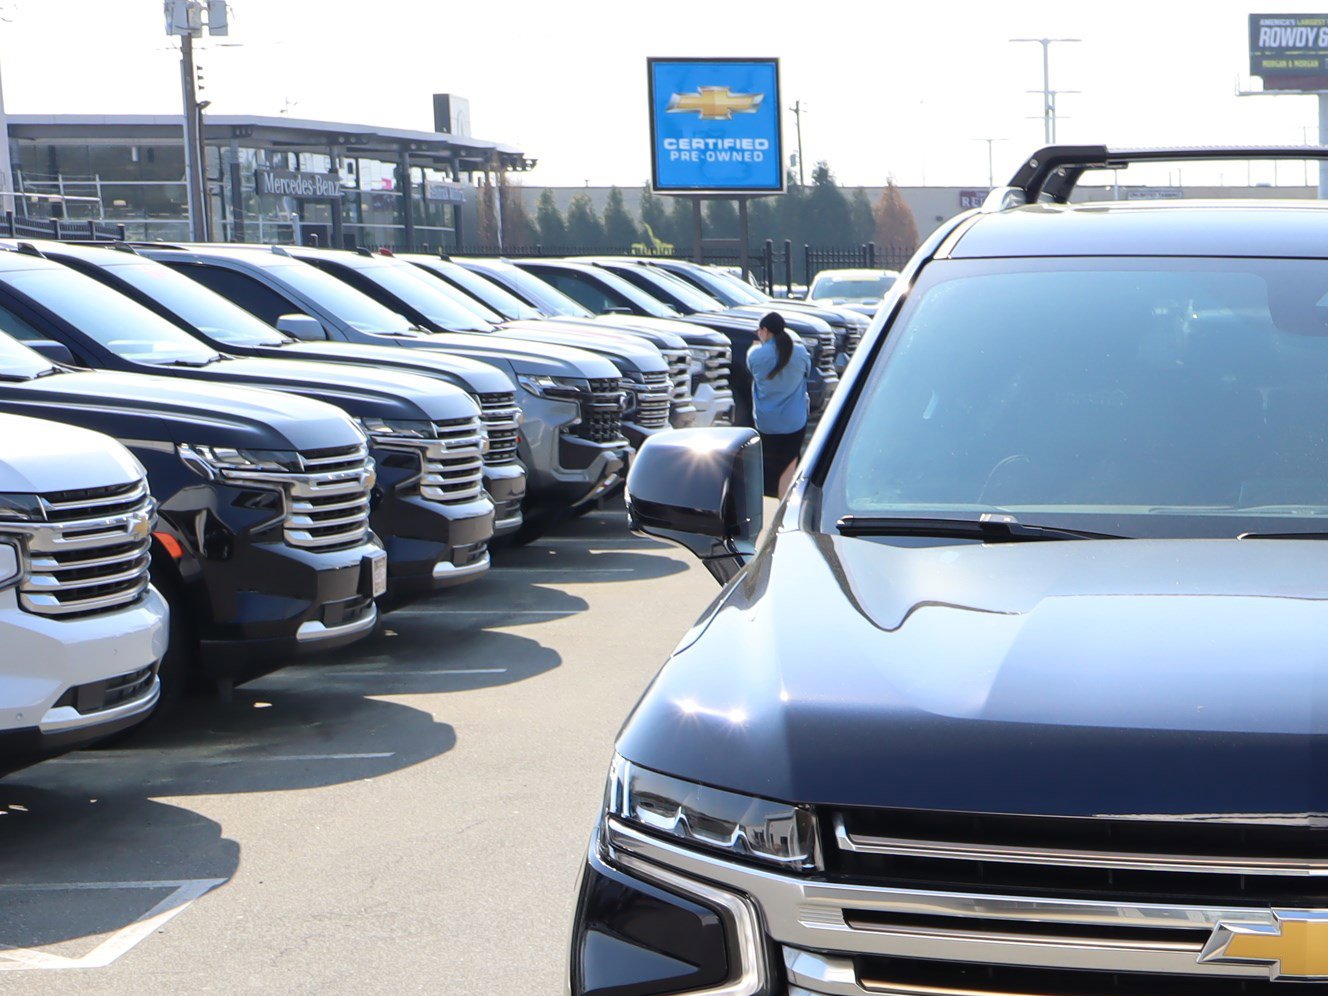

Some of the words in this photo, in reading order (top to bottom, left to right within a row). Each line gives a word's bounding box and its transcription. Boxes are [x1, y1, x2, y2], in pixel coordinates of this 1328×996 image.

[1258, 26, 1318, 47] ROWDY
[663, 138, 769, 150] CERTIFIED
[670, 151, 763, 162] PRE-OWNED
[264, 172, 340, 196] Mercedes-Benz
